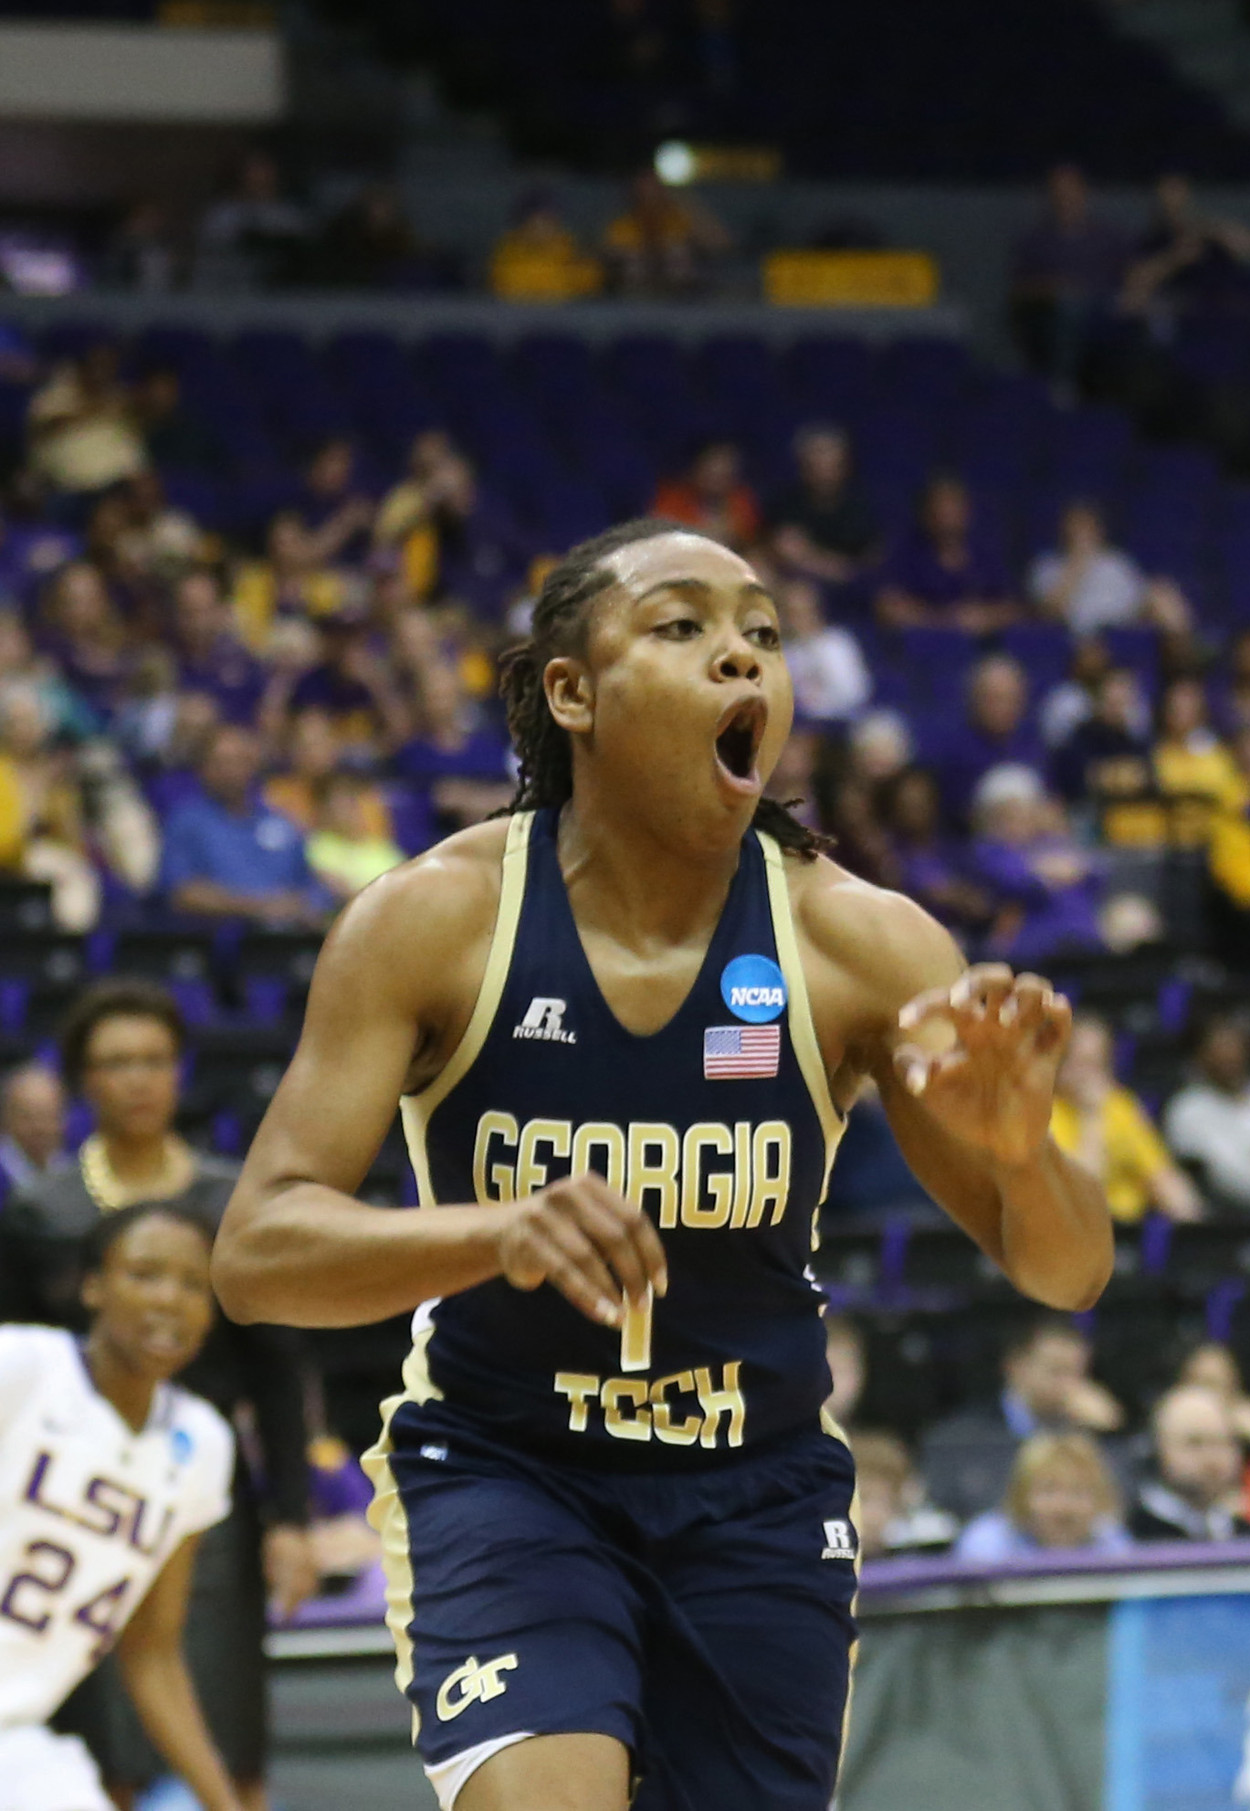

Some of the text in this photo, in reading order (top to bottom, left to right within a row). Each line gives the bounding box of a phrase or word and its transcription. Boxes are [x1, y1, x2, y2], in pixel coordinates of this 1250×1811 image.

[731, 986, 785, 1007] NCAA
[512, 1025, 577, 1044] RUSSELL
[473, 1110, 791, 1229] GEORGIA
[24, 1451, 176, 1557] LSU
[823, 1521, 850, 1549] R
[0, 1541, 133, 1662] 24
[437, 1653, 518, 1721] GT
